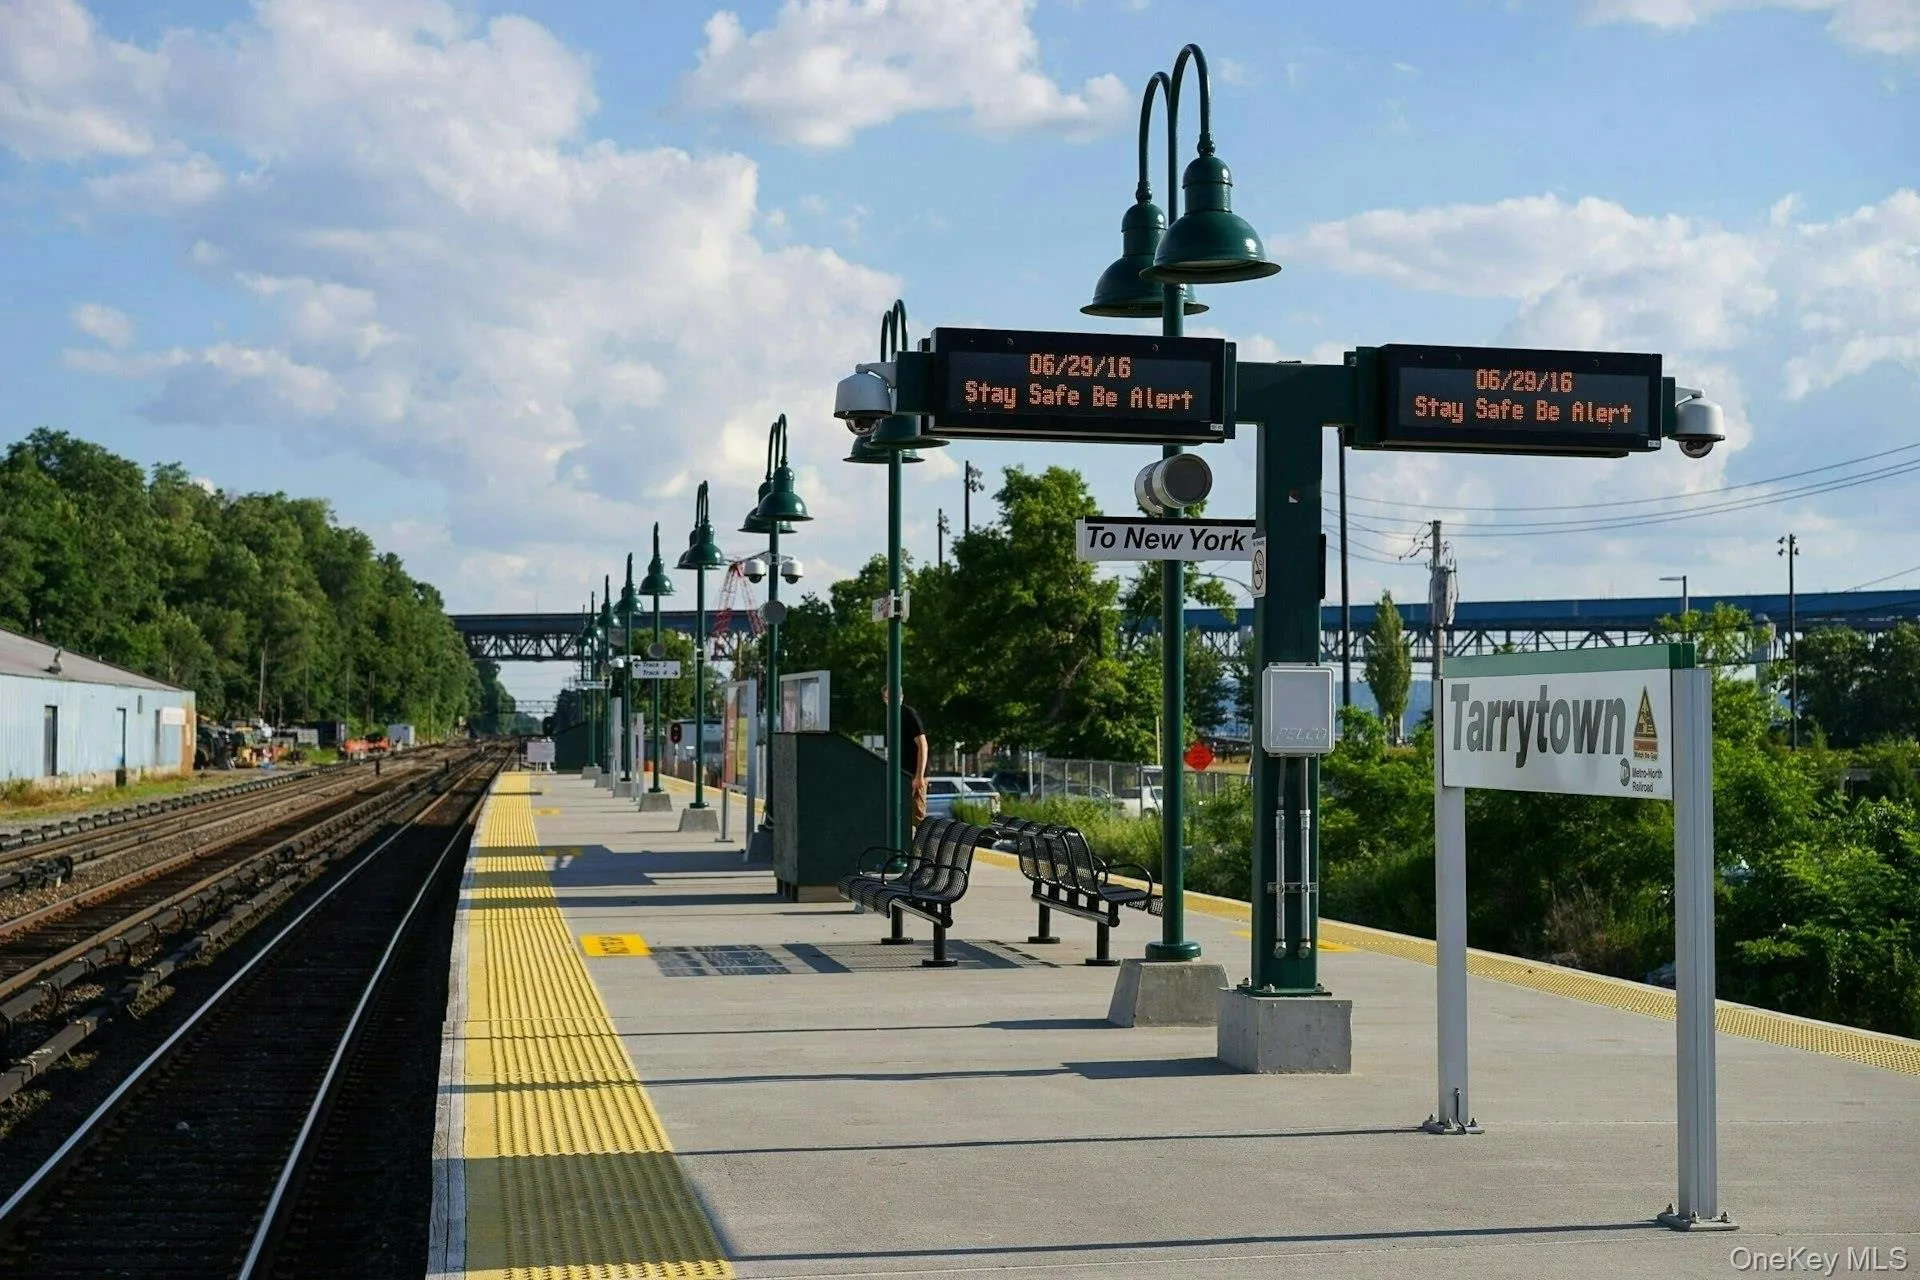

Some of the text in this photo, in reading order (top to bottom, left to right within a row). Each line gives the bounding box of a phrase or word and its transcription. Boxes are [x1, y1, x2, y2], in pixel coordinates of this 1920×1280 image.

[1029, 353, 1132, 379] 06/29/16
[1476, 369, 1573, 393] 06/29/16
[965, 380, 1193, 410] Stay Safe Be Alert
[1415, 395, 1632, 424] Stay Safe Be Alert
[1086, 525, 1246, 552] To New York
[1450, 683, 1626, 769] Tarrytown
[1632, 767, 1663, 779] Metro-North
[1632, 781, 1654, 793] Railroad
